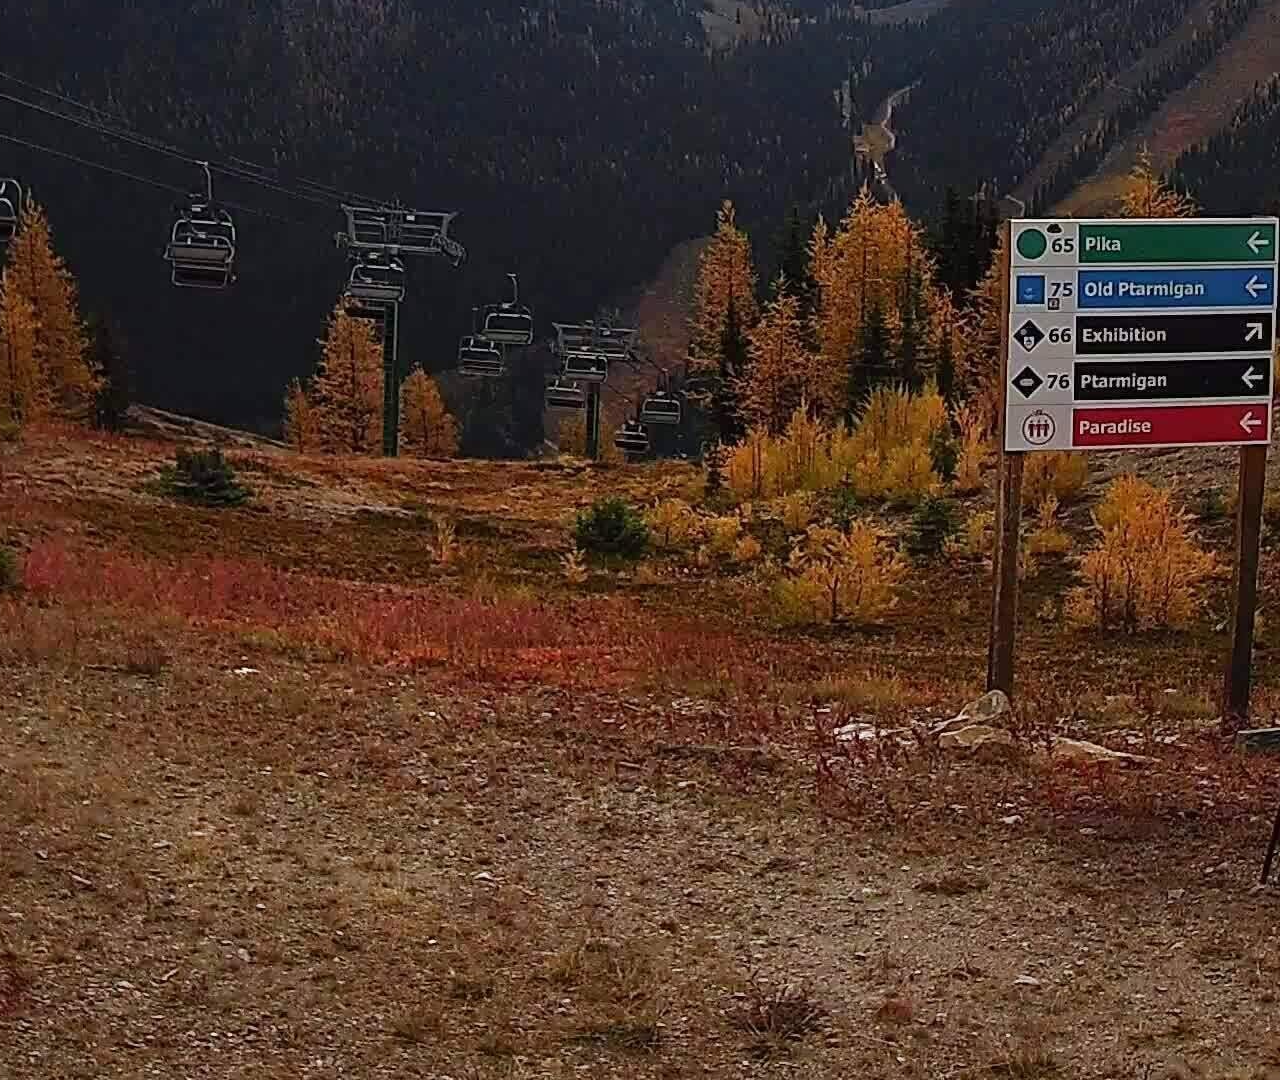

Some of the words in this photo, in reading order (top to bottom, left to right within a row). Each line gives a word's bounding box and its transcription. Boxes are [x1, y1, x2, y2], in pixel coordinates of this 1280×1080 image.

[1051, 237, 1075, 253] 65
[1084, 236, 1121, 252] Pika
[1050, 282, 1073, 297] 75
[1084, 281, 1113, 297] Old
[1118, 279, 1205, 299] Ptarmigan
[1048, 328, 1072, 344] 66
[1082, 326, 1167, 343] Exhibition
[1047, 374, 1070, 390] 76
[1080, 372, 1168, 393] Ptarmigan
[1079, 419, 1152, 435] Paradise
